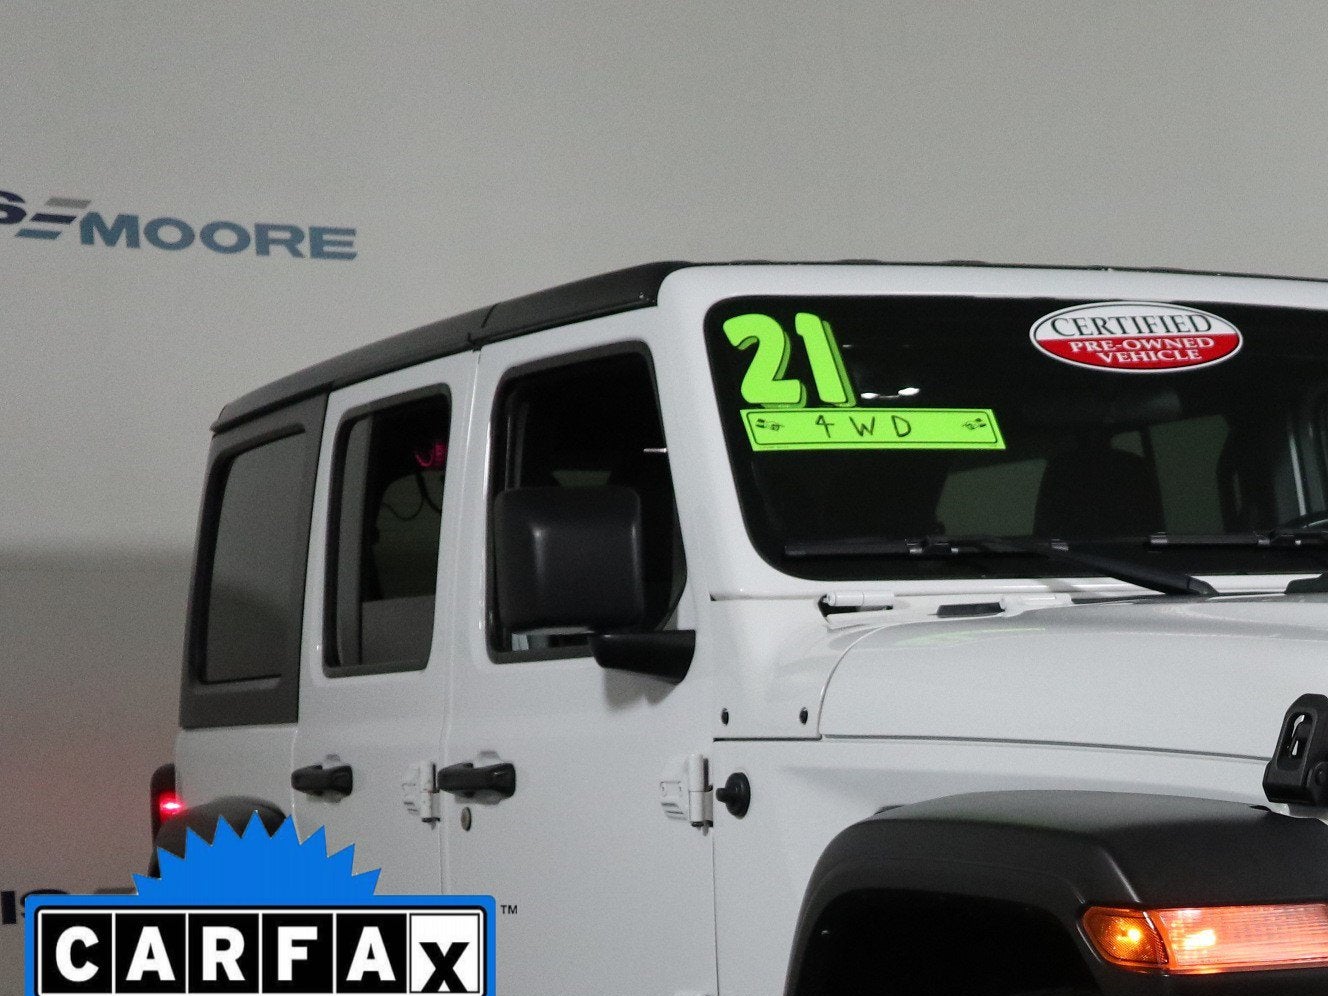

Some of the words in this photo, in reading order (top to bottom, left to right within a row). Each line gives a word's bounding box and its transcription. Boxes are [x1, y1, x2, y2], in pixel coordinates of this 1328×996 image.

[78, 211, 358, 261] MOORE
[1050, 314, 1212, 337] CERTIFIED
[1068, 337, 1214, 352] PRE-OWNED
[723, 312, 857, 408] 21
[1095, 350, 1202, 363] VEHICLE
